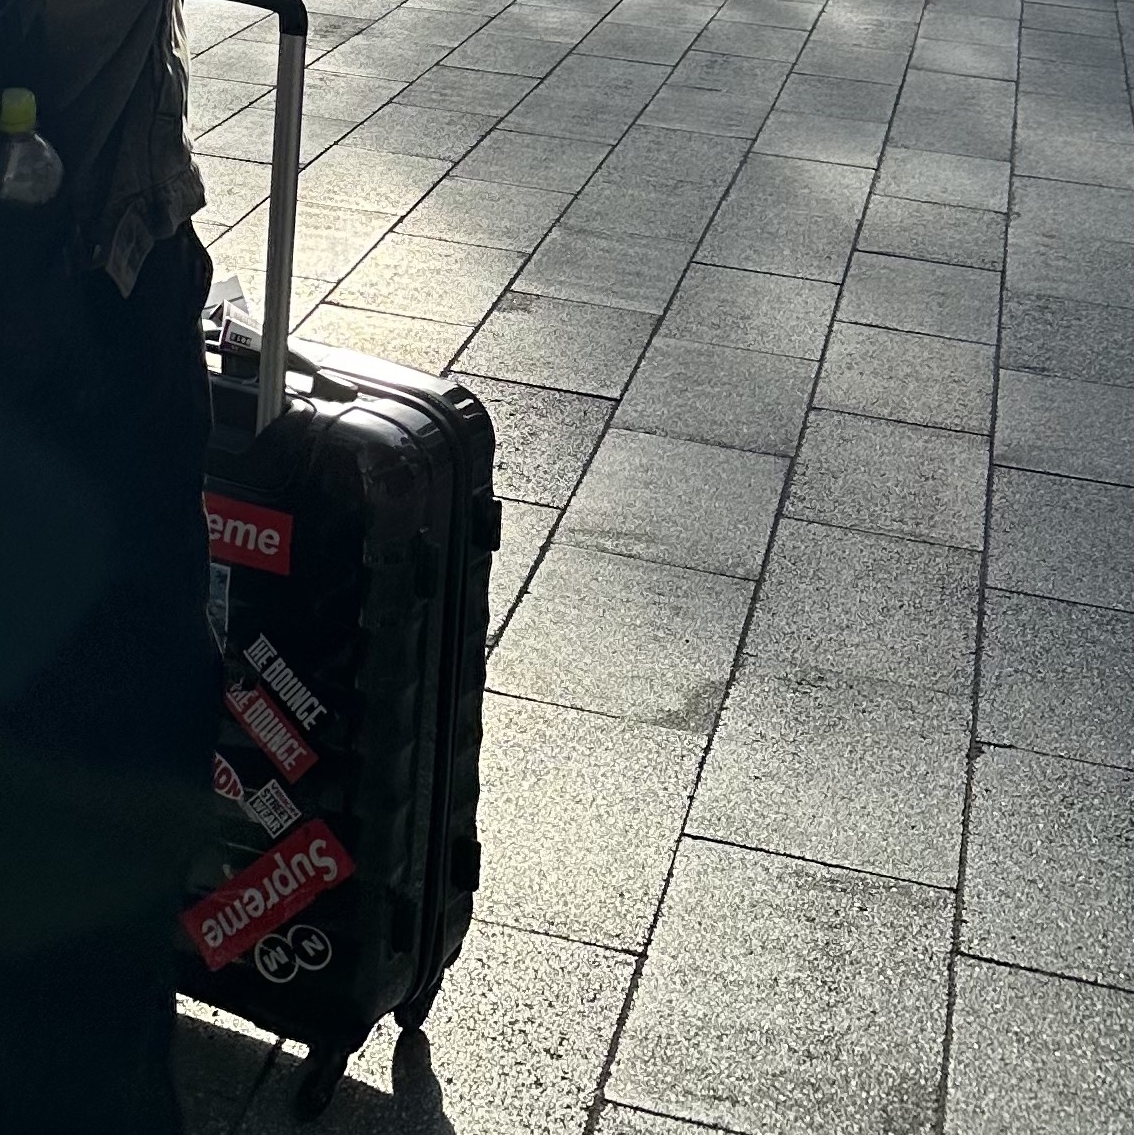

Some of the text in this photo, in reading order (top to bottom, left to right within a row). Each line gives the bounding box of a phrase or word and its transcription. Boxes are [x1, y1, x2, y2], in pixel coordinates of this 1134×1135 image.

[243, 633, 328, 732] THE BOUNCE
[243, 696, 308, 771] BOUNCE
[251, 797, 281, 836] WEAR
[260, 787, 293, 824] STREET
[202, 838, 338, 947] Supreme
